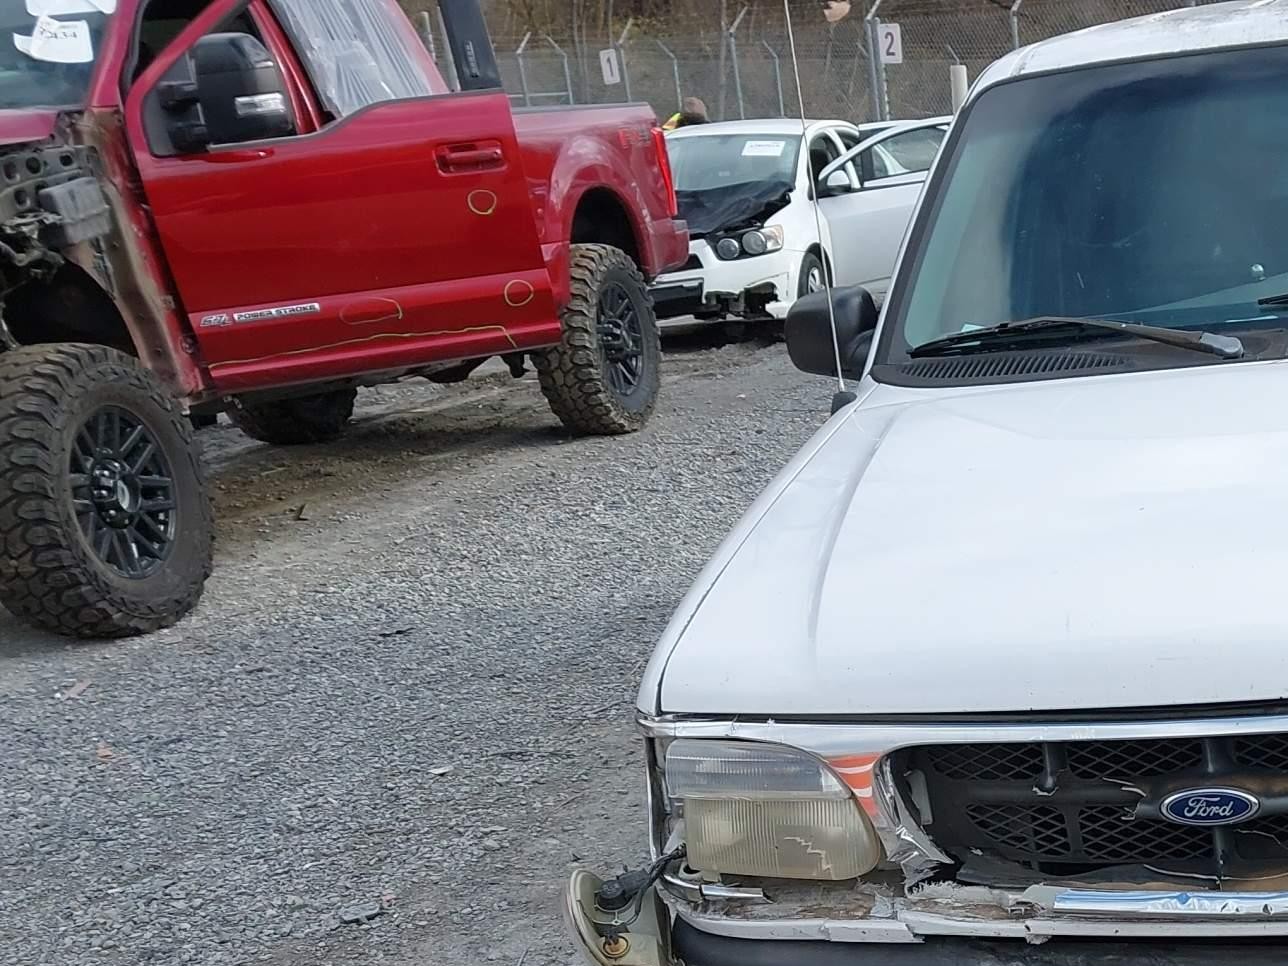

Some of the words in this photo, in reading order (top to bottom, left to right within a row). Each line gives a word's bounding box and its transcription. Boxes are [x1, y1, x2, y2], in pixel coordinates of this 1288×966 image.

[884, 31, 896, 57] 2
[605, 55, 615, 78] 1
[236, 310, 273, 321] POWER
[275, 304, 317, 316] STROKE
[1183, 796, 1234, 817] Ford
